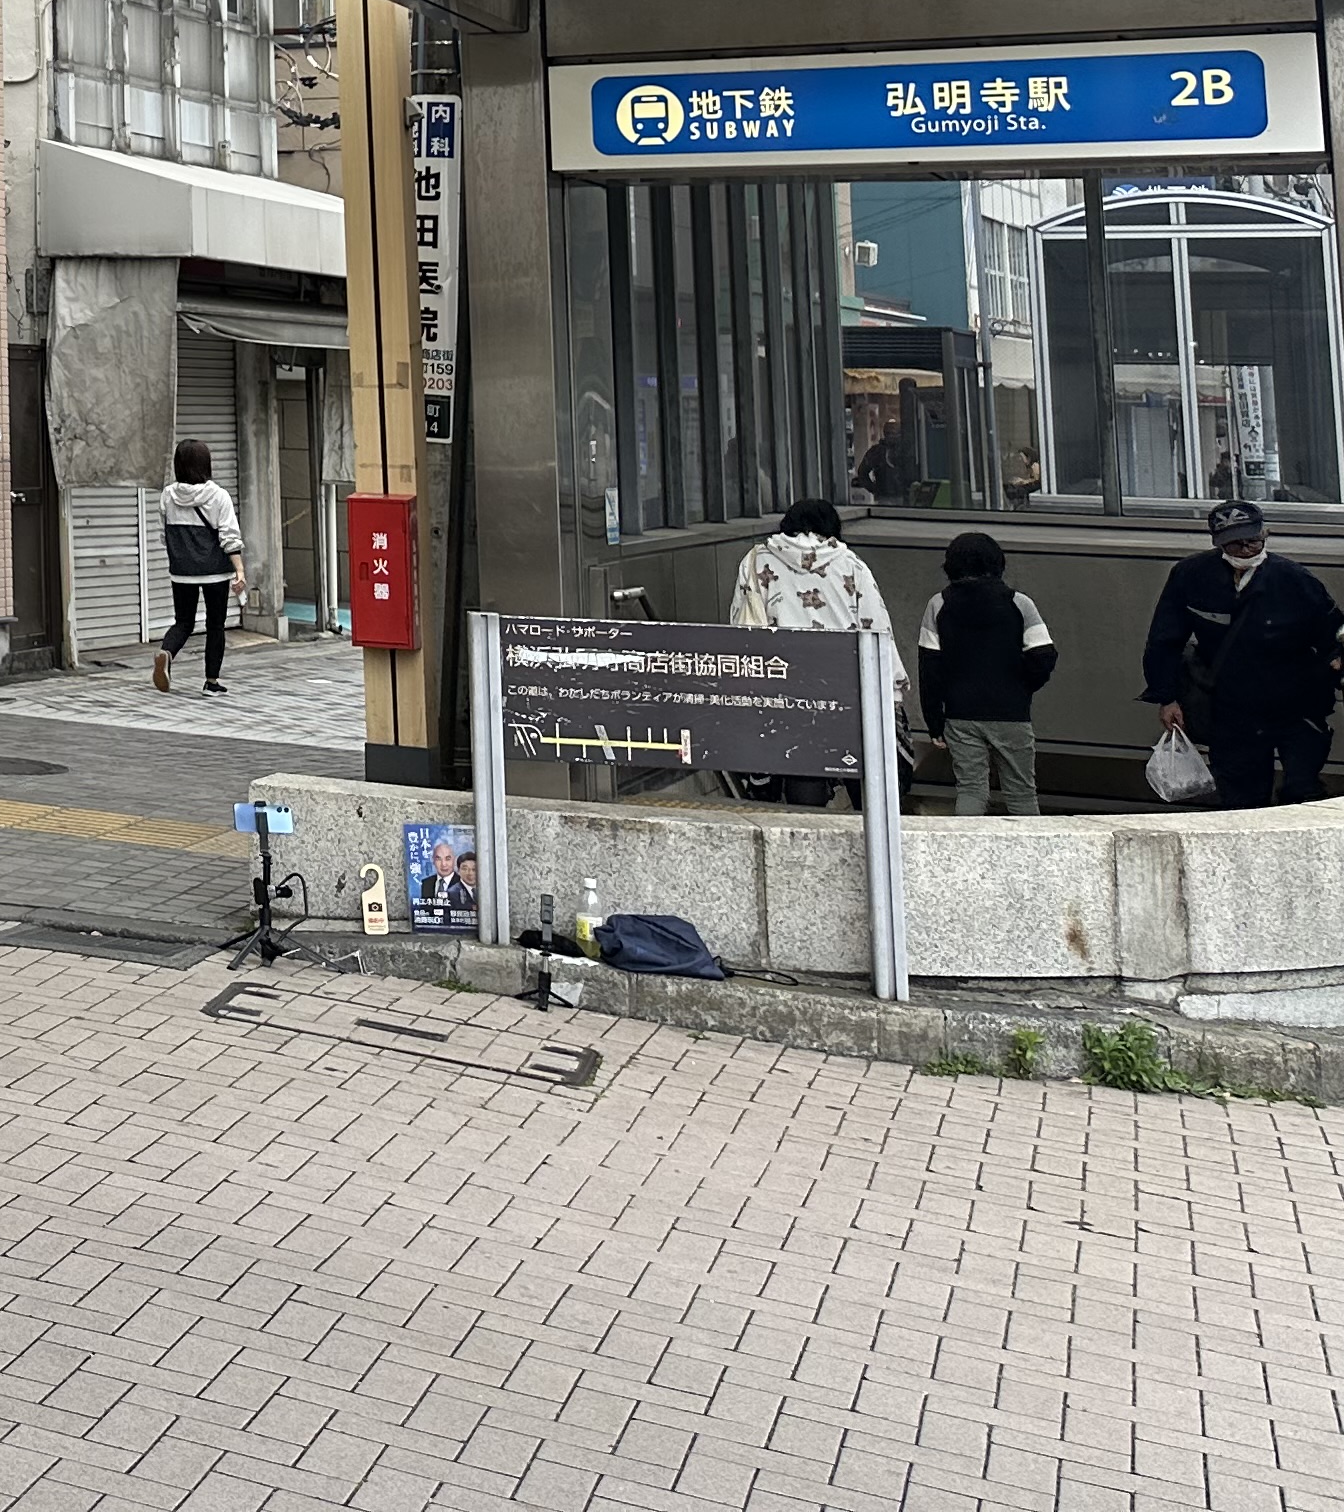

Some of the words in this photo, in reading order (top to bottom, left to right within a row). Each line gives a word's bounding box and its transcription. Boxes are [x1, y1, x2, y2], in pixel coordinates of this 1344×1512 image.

[688, 86, 795, 120] 地下鉄
[885, 75, 1072, 117] 弘明寺駅
[1169, 68, 1235, 108] 2B
[431, 104, 450, 156] 内科
[689, 118, 795, 141] SUBWAY
[911, 113, 1000, 135] Gumyoji
[1006, 112, 1047, 133] Sta.
[372, 532, 390, 600] 消火器
